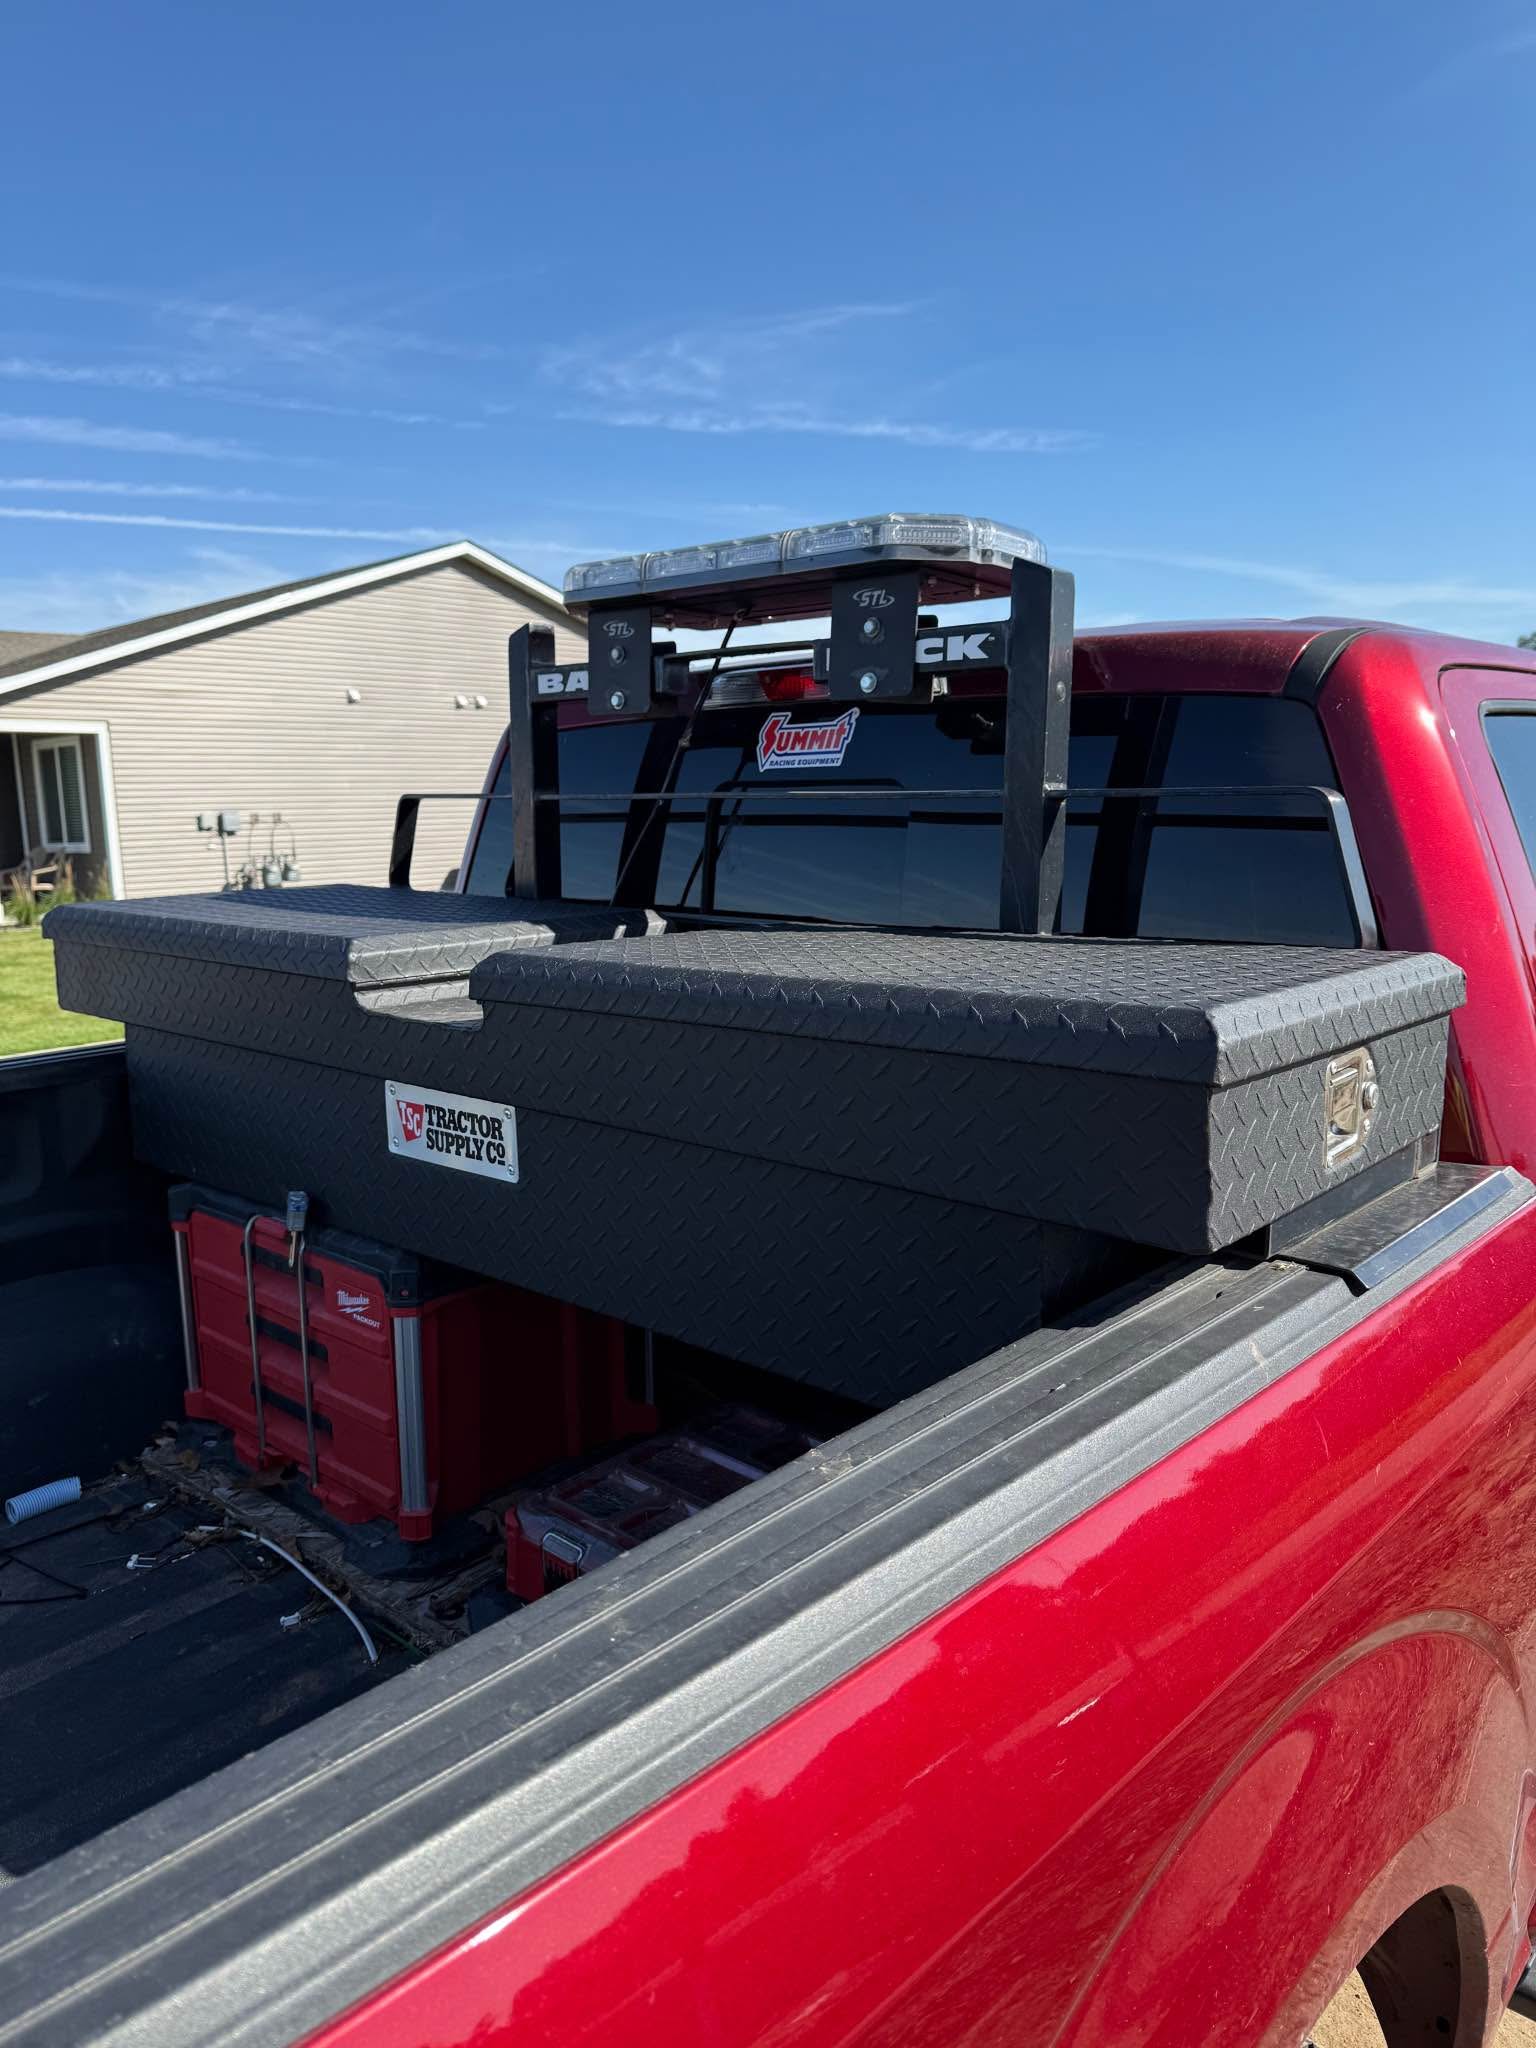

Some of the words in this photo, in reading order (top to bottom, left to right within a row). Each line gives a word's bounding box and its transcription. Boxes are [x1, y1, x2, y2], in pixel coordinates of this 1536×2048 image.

[858, 589, 890, 607] STL
[607, 621, 631, 637] STL
[537, 670, 589, 694] BA
[768, 758, 795, 767] RACING
[796, 757, 840, 767] EQUIPMENT
[399, 1102, 422, 1138] TSC
[424, 1103, 504, 1141] TRACTOR
[425, 1127, 485, 1161] SUPPLY
[352, 1313, 381, 1329] PACKOUT
